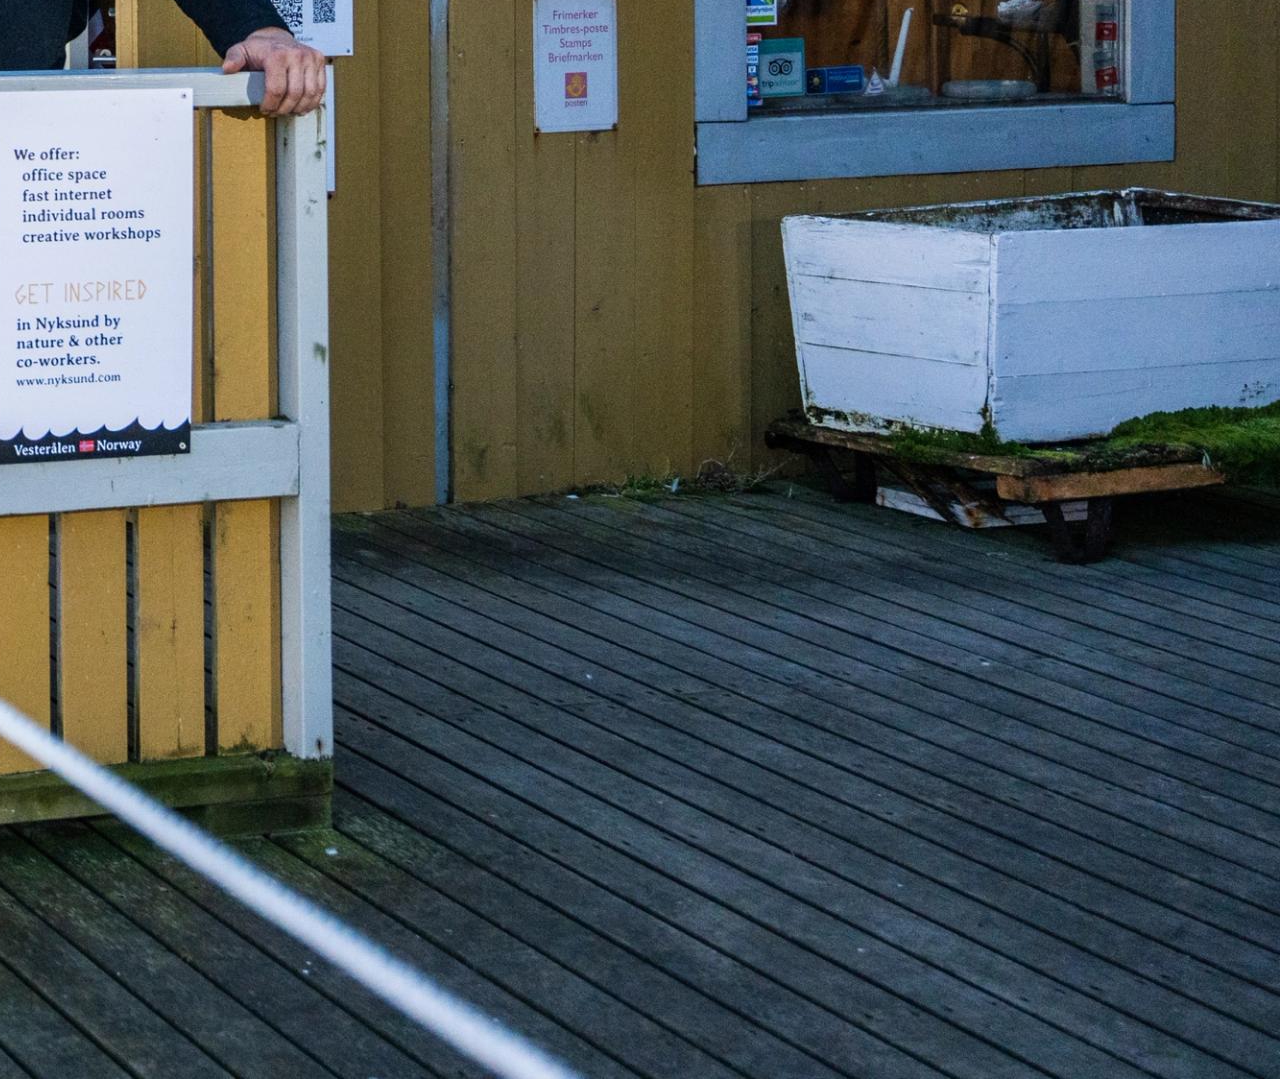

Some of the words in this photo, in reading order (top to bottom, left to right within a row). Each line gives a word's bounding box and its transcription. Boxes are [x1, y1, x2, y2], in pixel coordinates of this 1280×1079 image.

[552, 9, 599, 21] Frimerker
[542, 24, 609, 36] Timbres-poste
[559, 39, 592, 50] Stamps
[548, 51, 604, 63] Briefmarken
[564, 99, 588, 108] posten
[13, 148, 35, 161] We
[39, 148, 80, 161] offer:
[22, 168, 64, 182] office
[68, 169, 108, 184] space
[22, 189, 49, 202] fast
[54, 188, 112, 201] internet
[22, 208, 97, 223] individual
[101, 208, 145, 220] rooms
[22, 229, 80, 243] creative
[85, 227, 161, 242] workshops
[14, 283, 54, 305] GET
[64, 279, 147, 303] INSPIRED
[16, 318, 31, 331] in
[36, 315, 100, 333] Nyksund
[104, 314, 121, 331] by
[16, 337, 64, 350] nature
[68, 335, 80, 347] &
[85, 333, 123, 347] other
[16, 353, 101, 368] co-workers.
[16, 372, 122, 388] www.nyksund.com
[13, 441, 76, 457] Vesterålen
[96, 439, 142, 452] Norway
